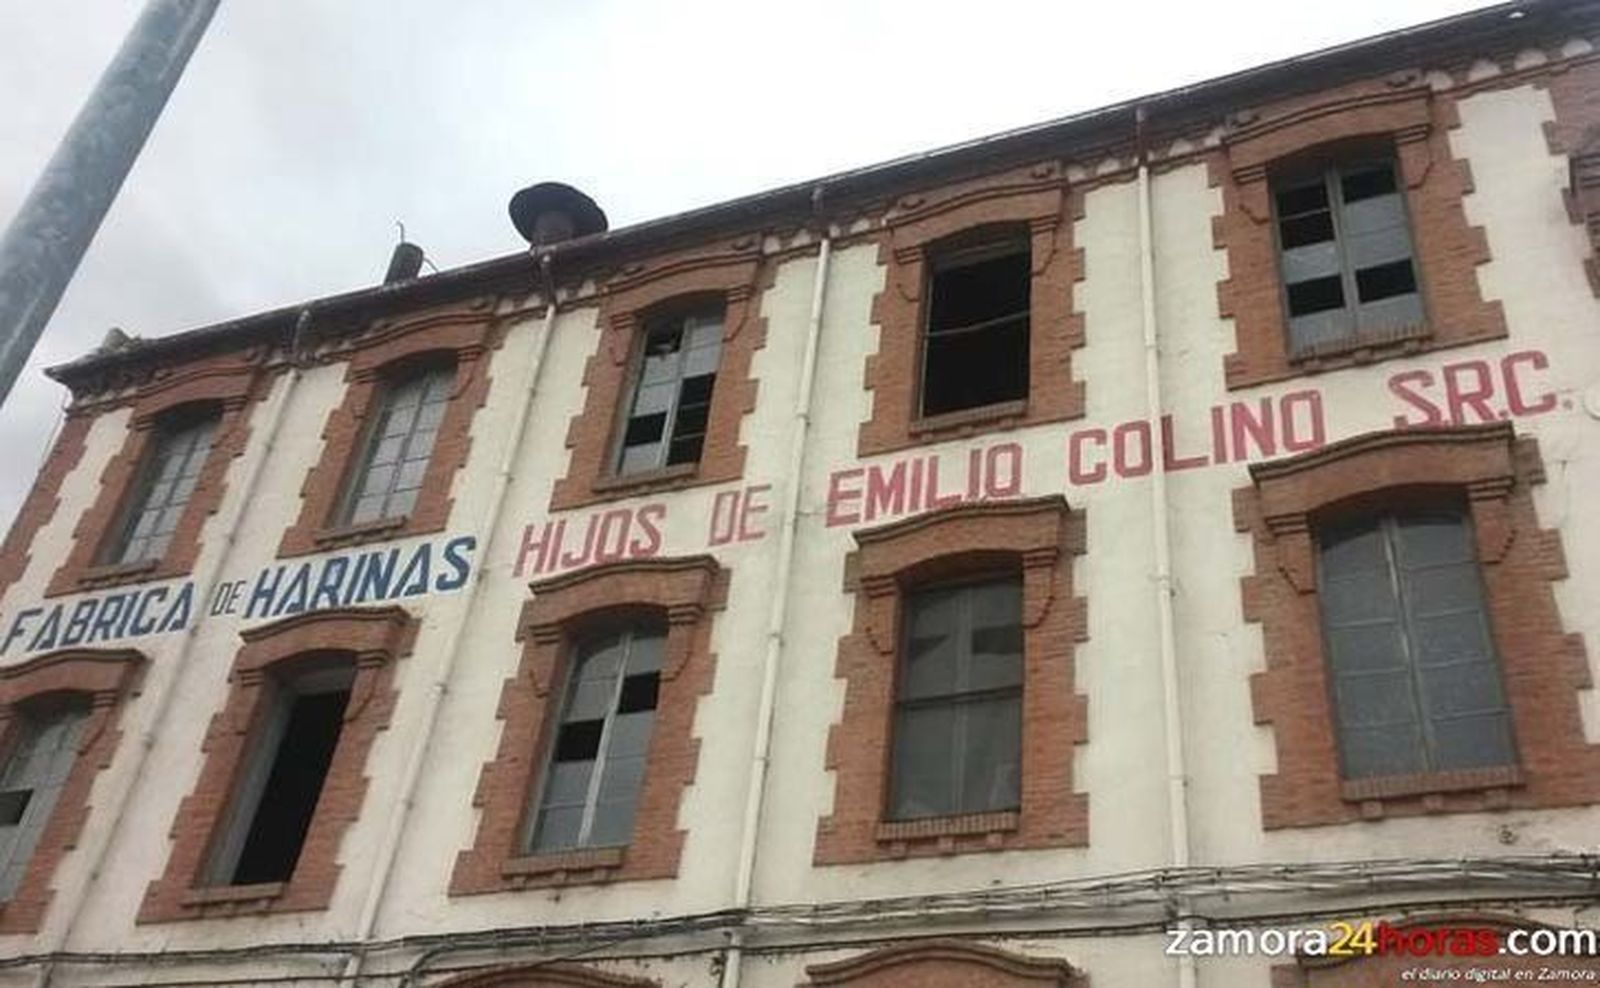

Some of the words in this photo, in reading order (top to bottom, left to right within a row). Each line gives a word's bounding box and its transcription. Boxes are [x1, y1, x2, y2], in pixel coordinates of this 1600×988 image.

[0, 582, 195, 655] FABRICA
[210, 581, 246, 616] DE
[243, 536, 476, 619] HARINAS
[512, 503, 667, 577] HIJOS
[707, 484, 771, 547] DE
[826, 442, 1023, 528] EMILIO
[1068, 389, 1326, 486] COLINO
